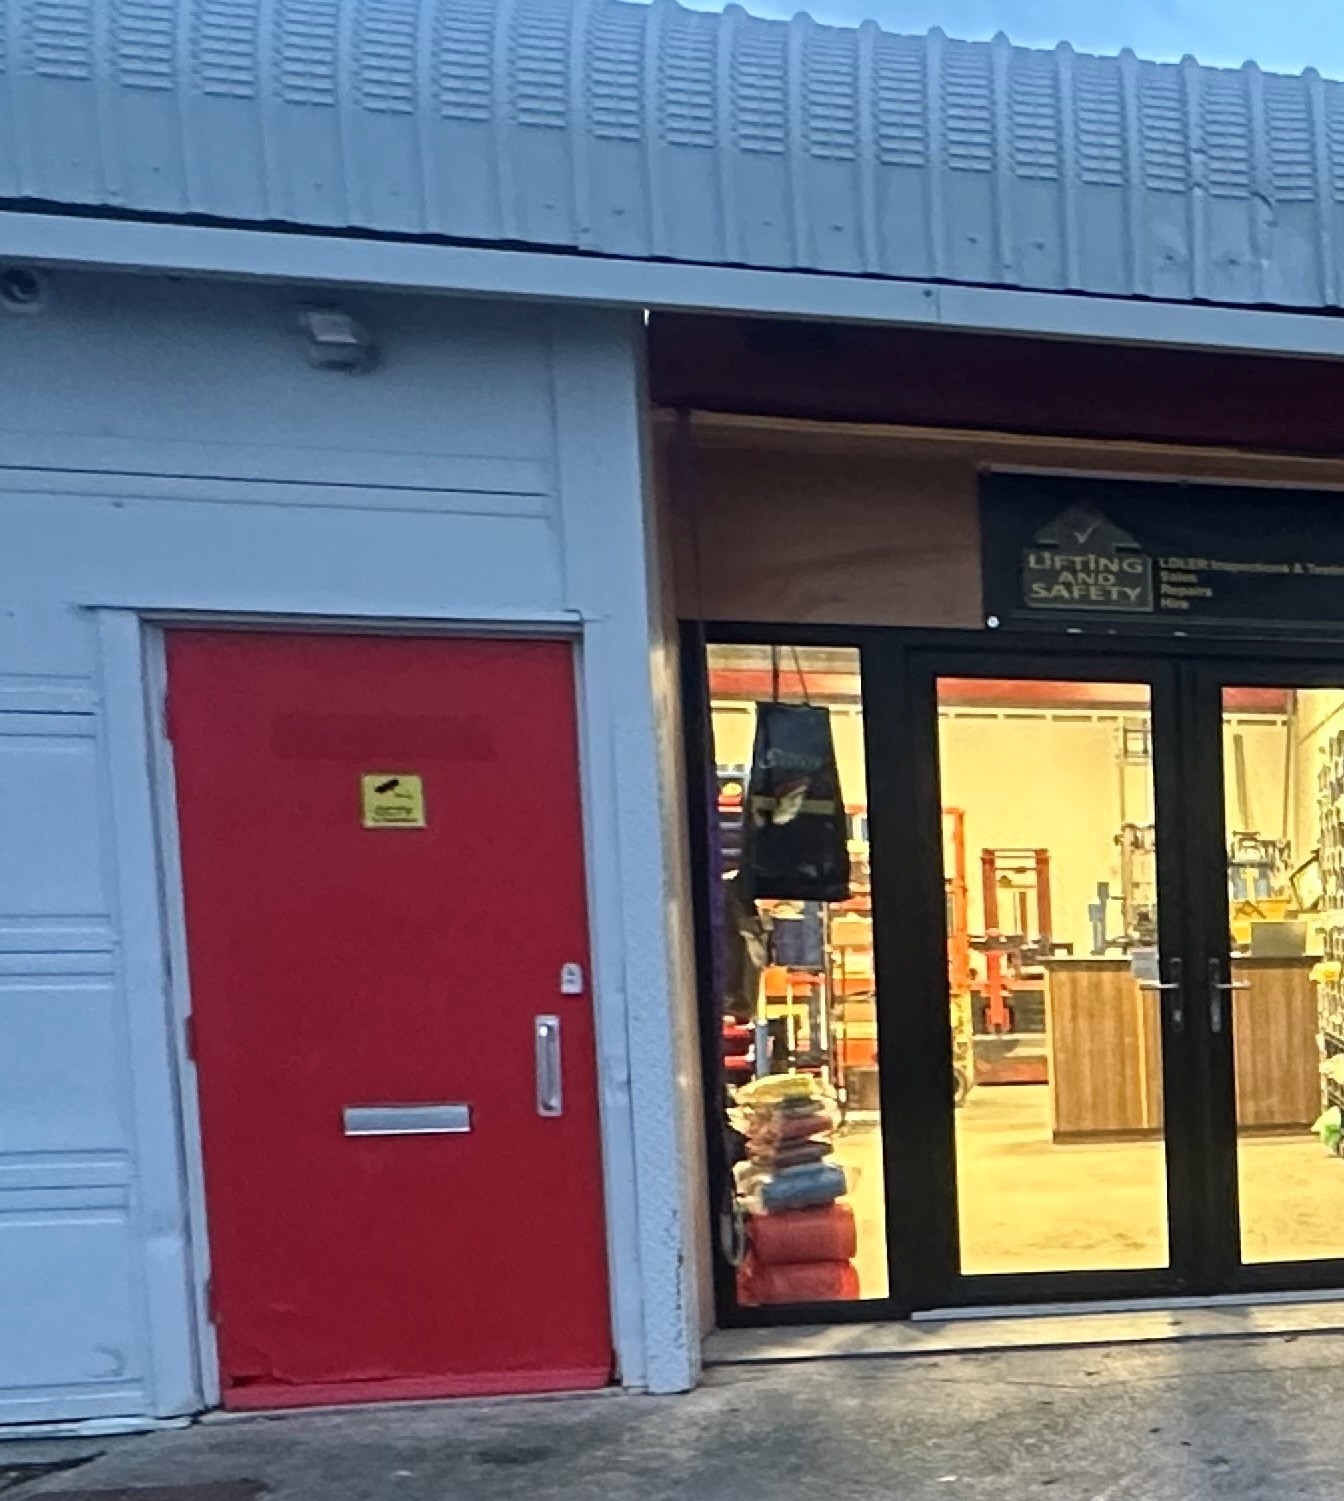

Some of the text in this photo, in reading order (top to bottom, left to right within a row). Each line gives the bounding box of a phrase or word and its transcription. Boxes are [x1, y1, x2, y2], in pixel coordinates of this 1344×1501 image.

[1028, 551, 1144, 575] LIFTING
[1058, 571, 1116, 587] AND
[1030, 583, 1142, 603] SAFETY
